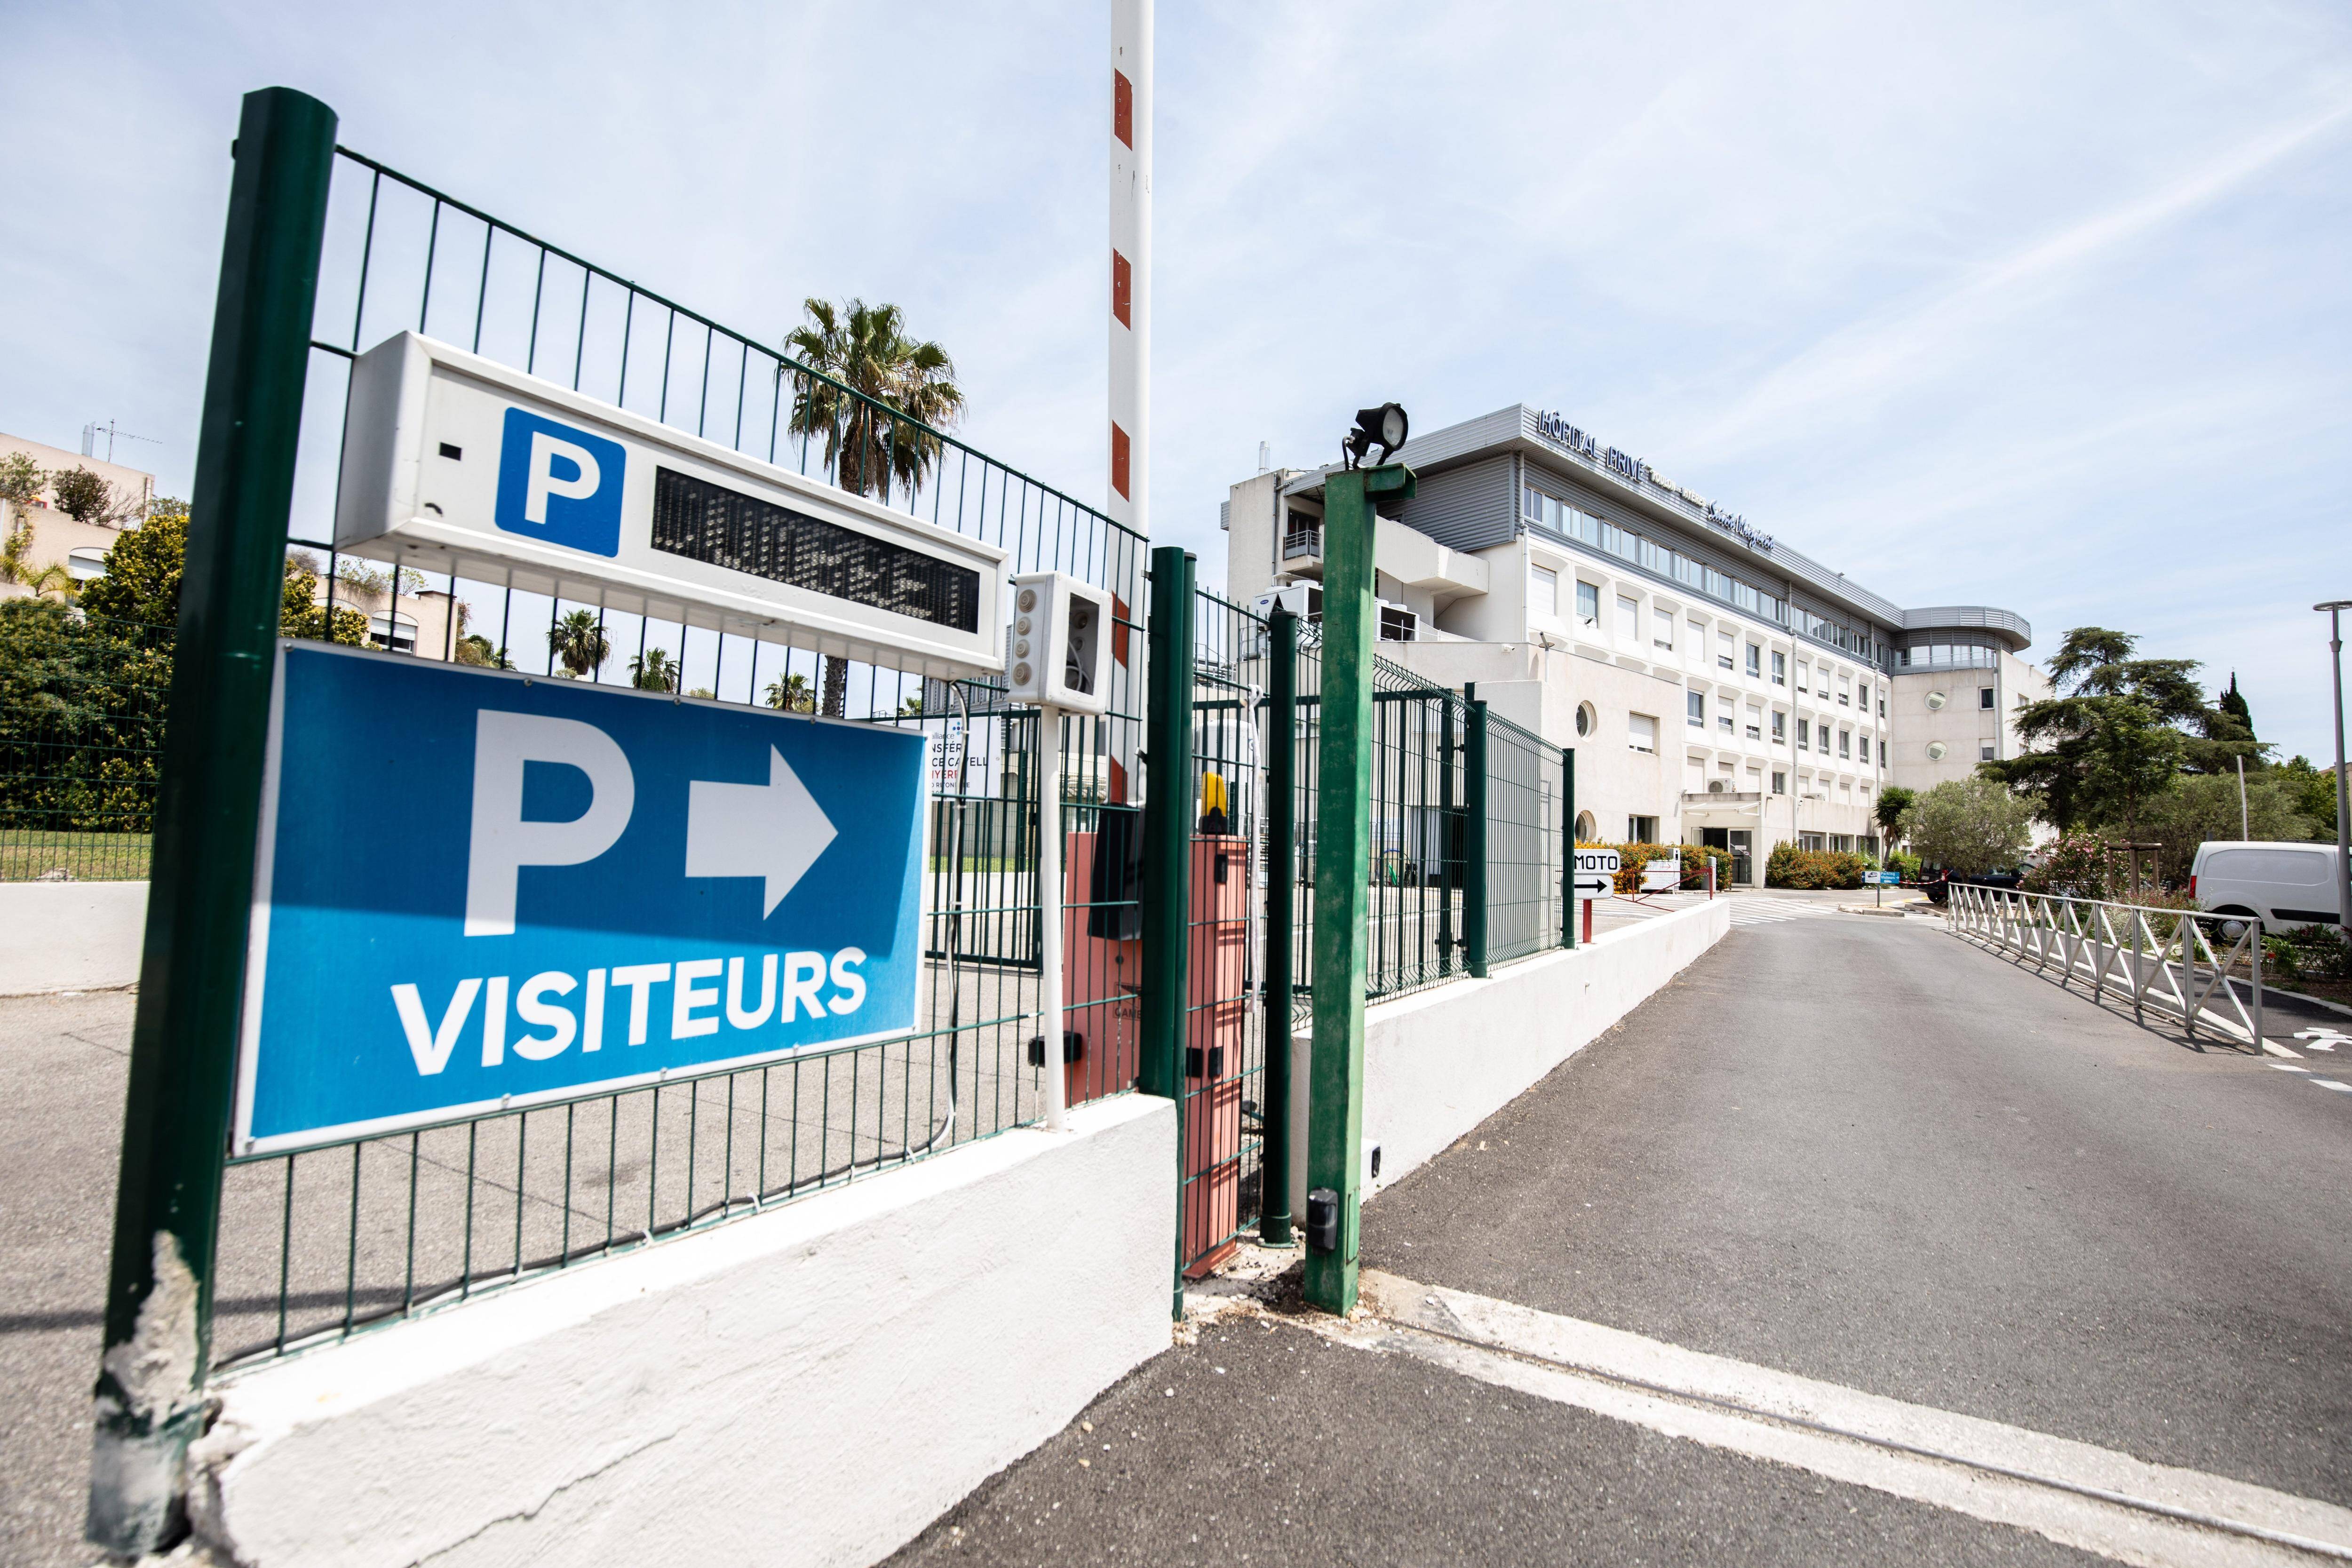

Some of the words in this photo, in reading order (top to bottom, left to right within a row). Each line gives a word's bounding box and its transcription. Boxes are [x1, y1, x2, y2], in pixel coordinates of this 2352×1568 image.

[524, 430, 601, 525] P
[1538, 409, 1599, 461] HÔPITAL
[1607, 446, 1645, 484] PRIVÉ
[1650, 470, 1676, 492] TOULON
[463, 709, 635, 937] P
[1574, 855, 1617, 870] MOTO
[390, 946, 867, 1076] VISITEURS
